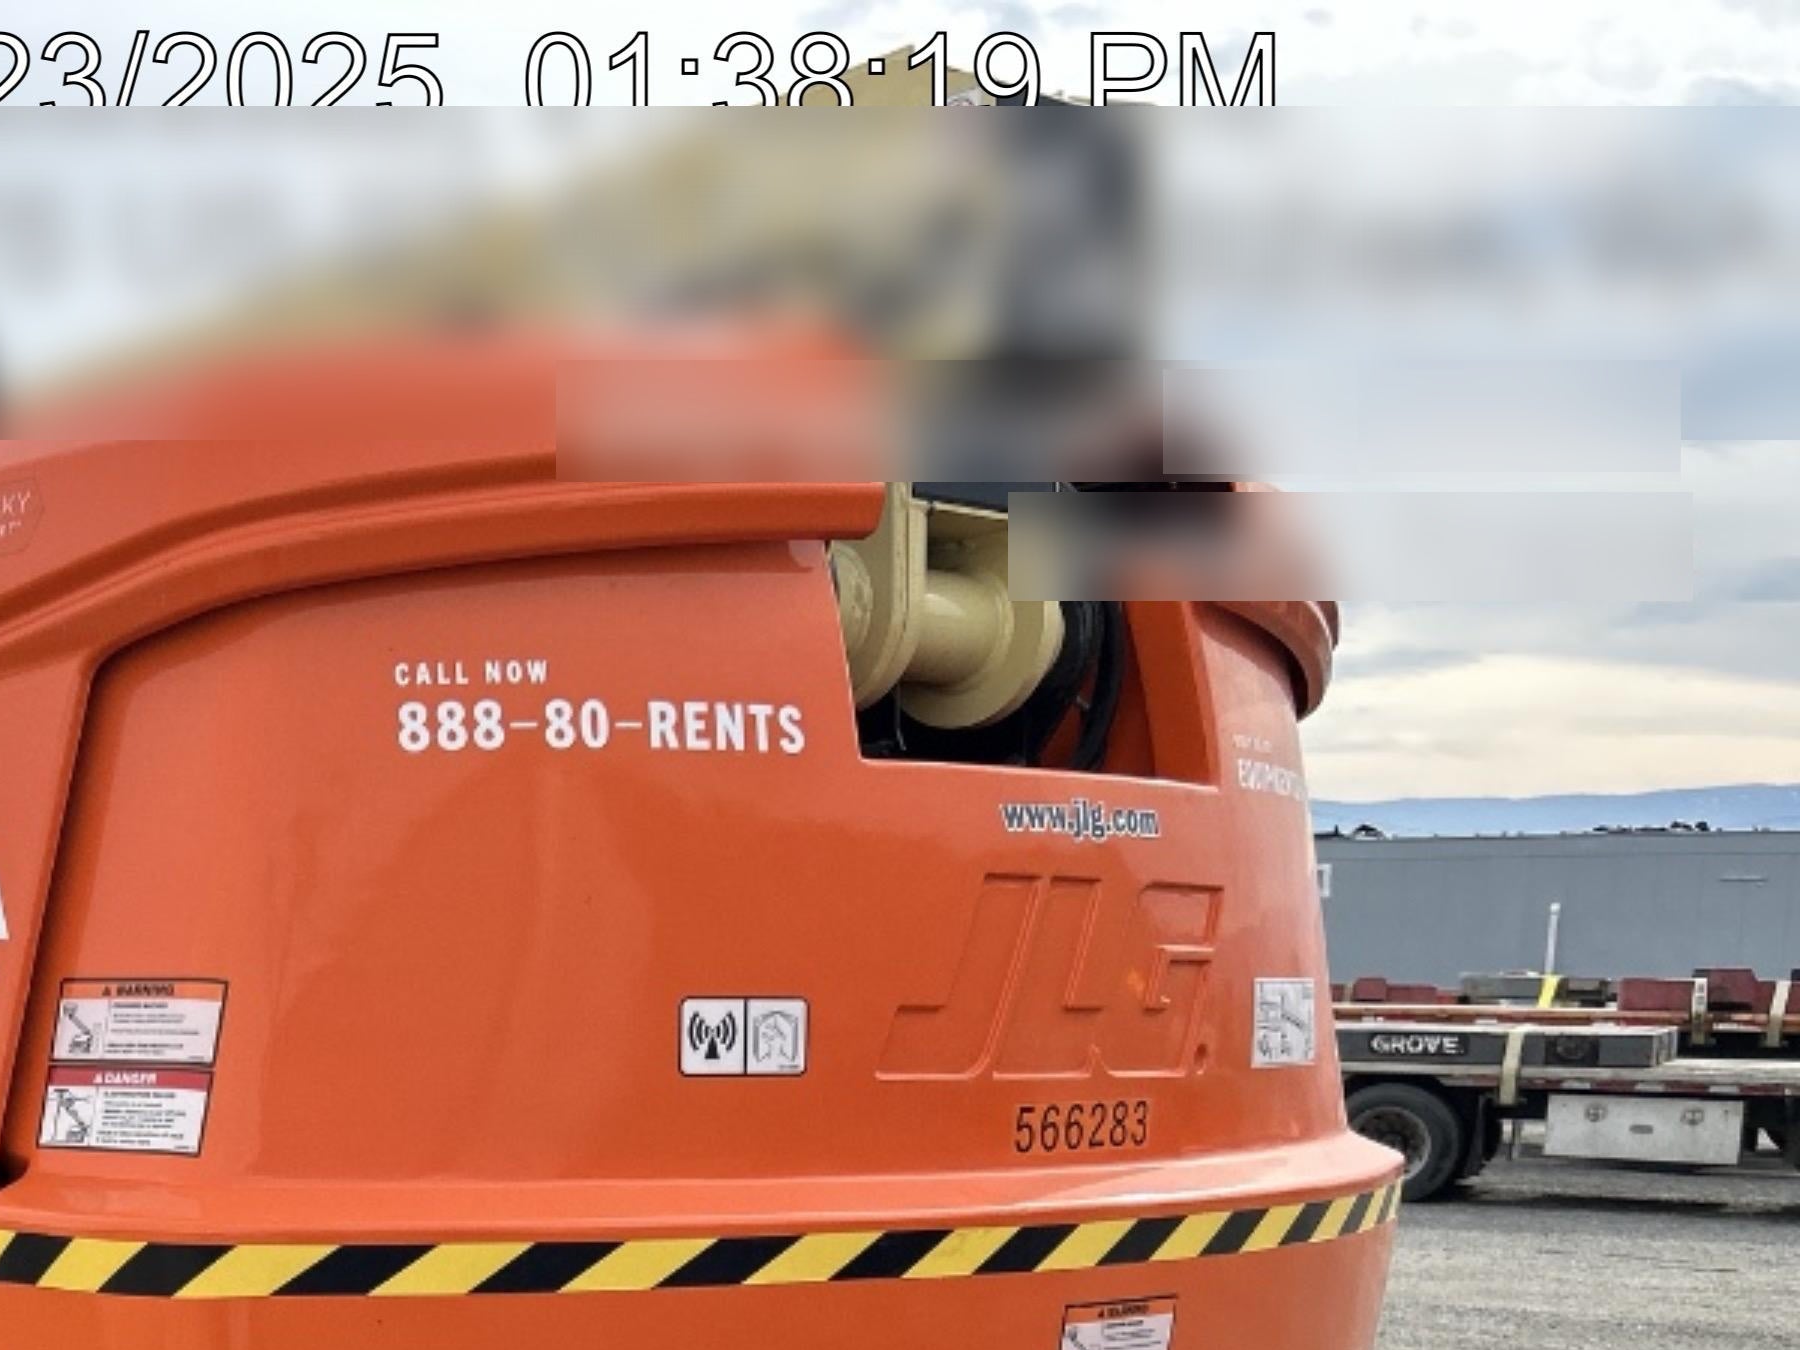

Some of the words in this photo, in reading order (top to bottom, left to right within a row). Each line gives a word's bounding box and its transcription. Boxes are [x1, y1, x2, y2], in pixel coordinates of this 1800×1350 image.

[394, 661, 470, 686] CALL
[485, 659, 548, 684] NOW
[397, 698, 806, 754] 888-80-RENTS
[1002, 799, 1162, 841] www.jlg.com
[874, 870, 1225, 1081] JLG
[1014, 1100, 1149, 1153] 566283
